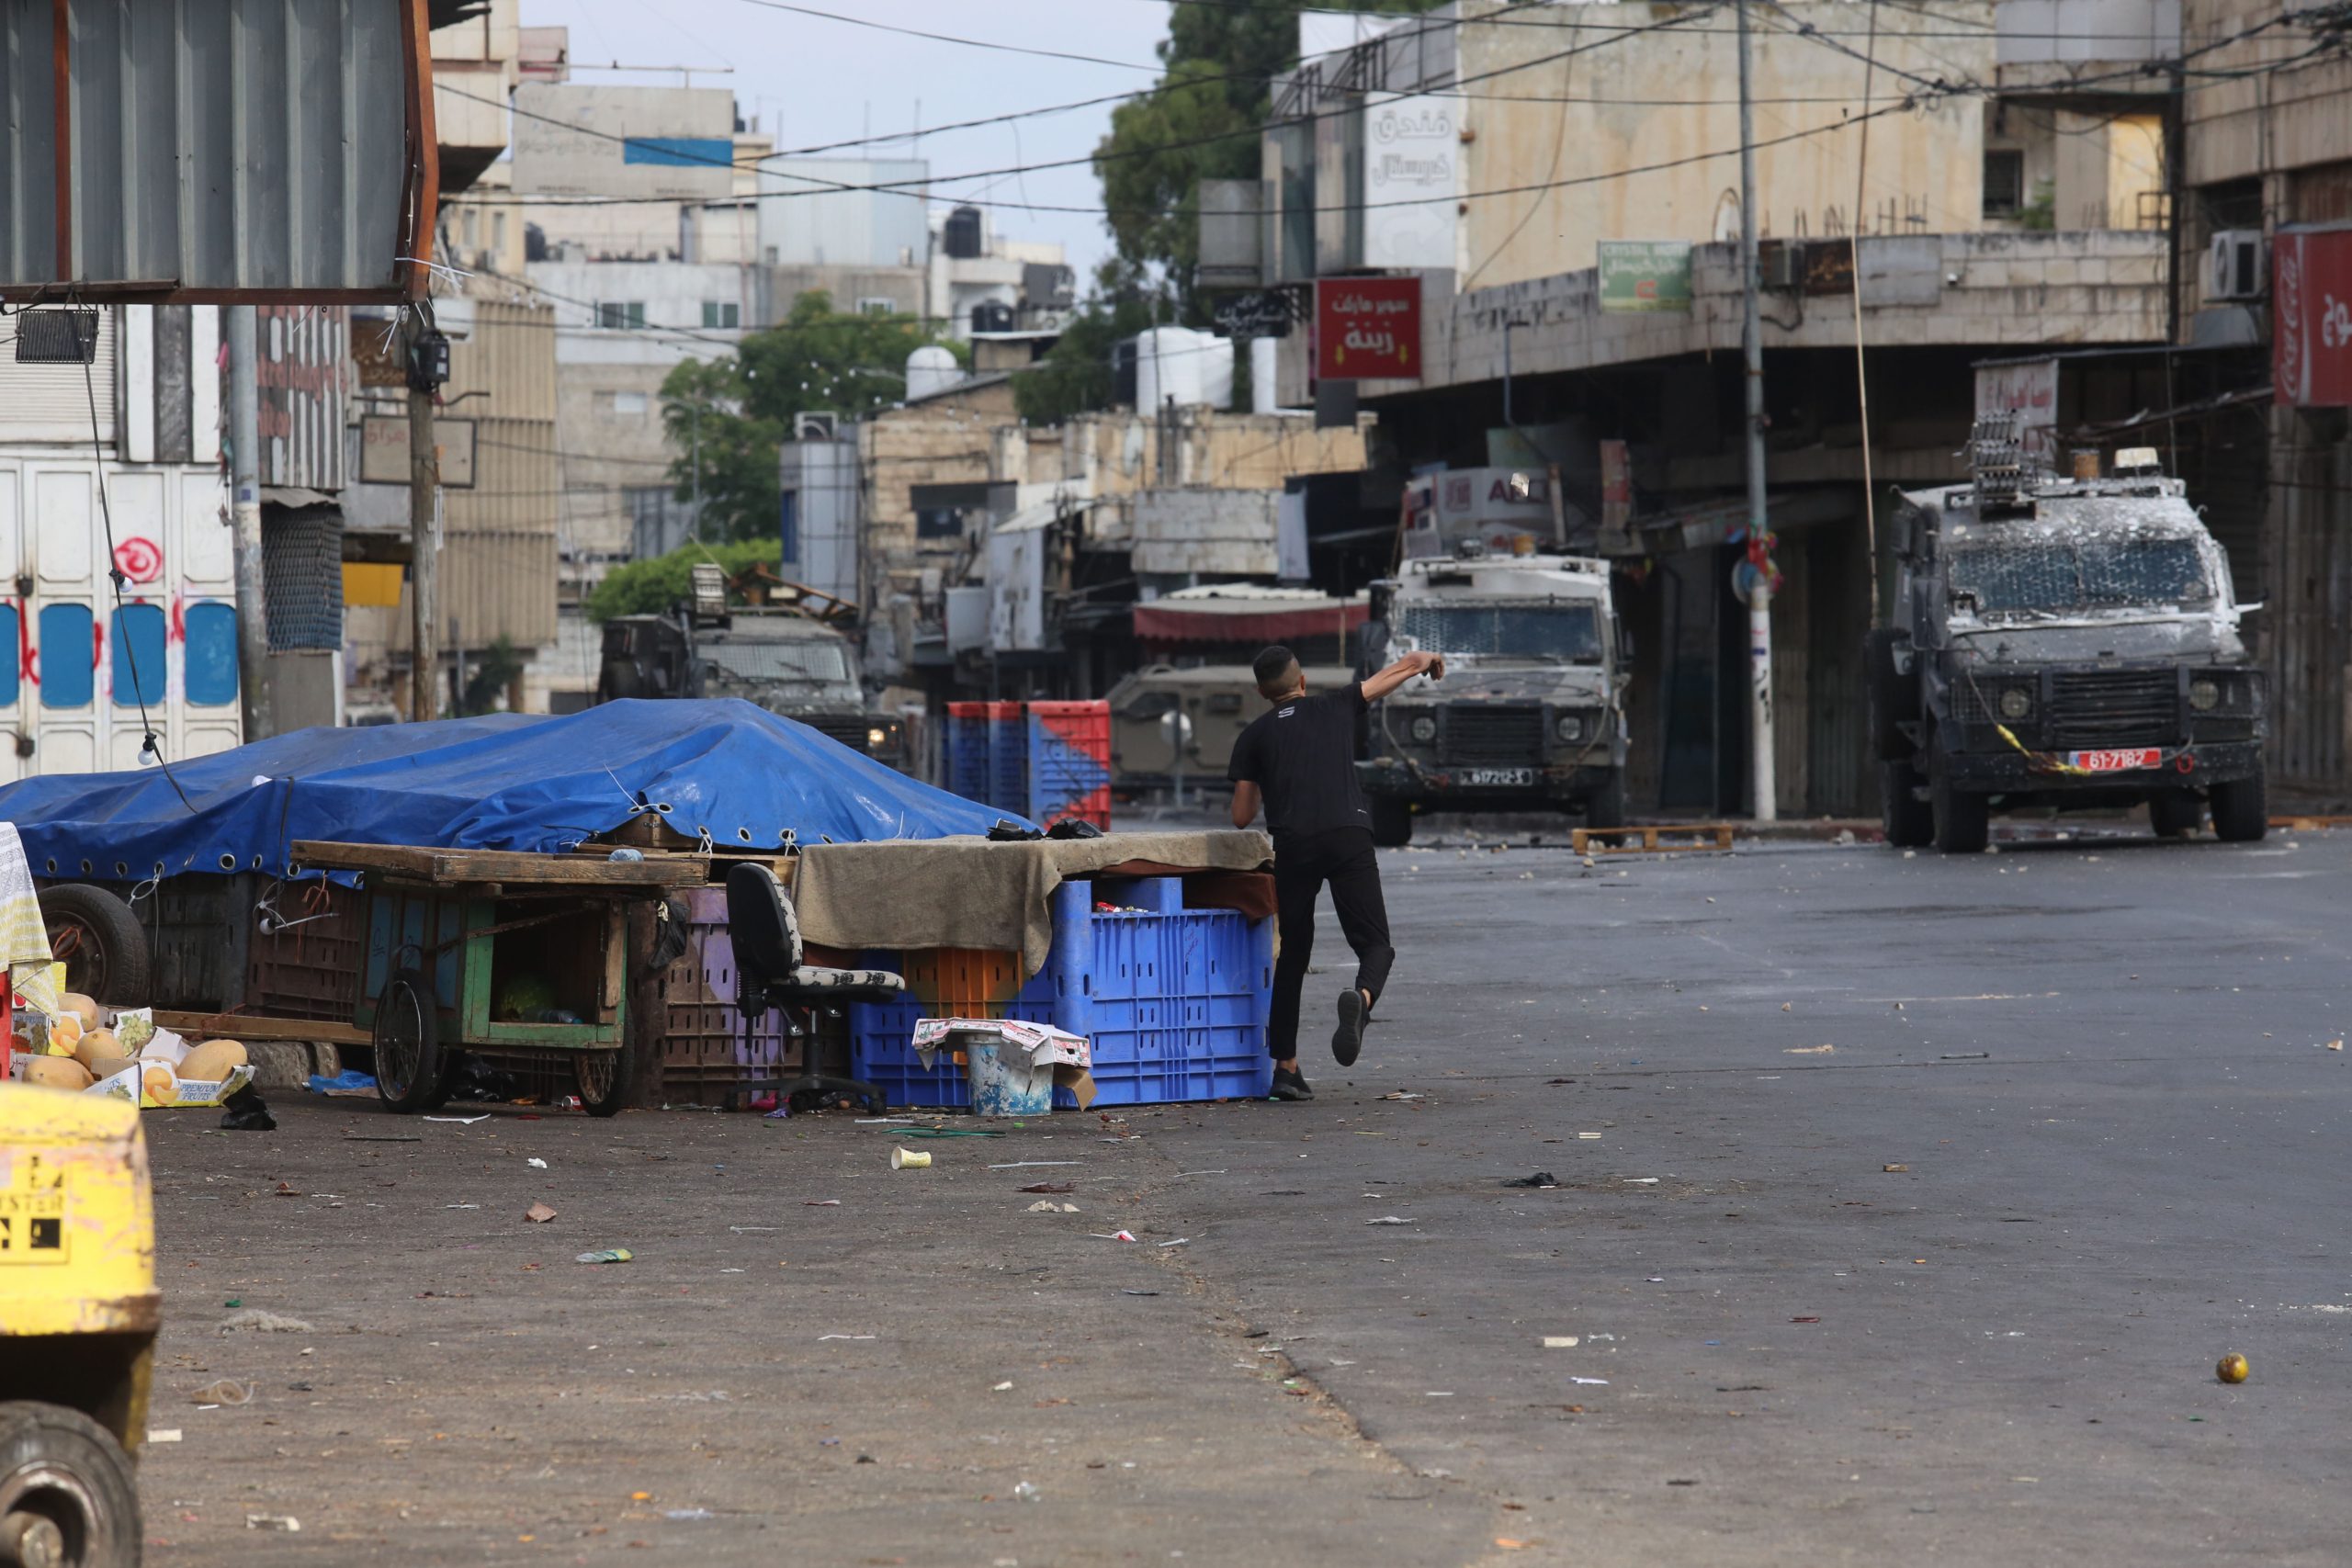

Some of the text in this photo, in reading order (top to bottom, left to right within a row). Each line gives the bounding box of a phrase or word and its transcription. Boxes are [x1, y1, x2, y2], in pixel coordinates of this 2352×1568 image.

[1373, 111, 1452, 145] فندق
[1372, 153, 1452, 187] كريستال
[1345, 321, 1395, 355] زينة
[182, 1092, 211, 1101] FRUITS
